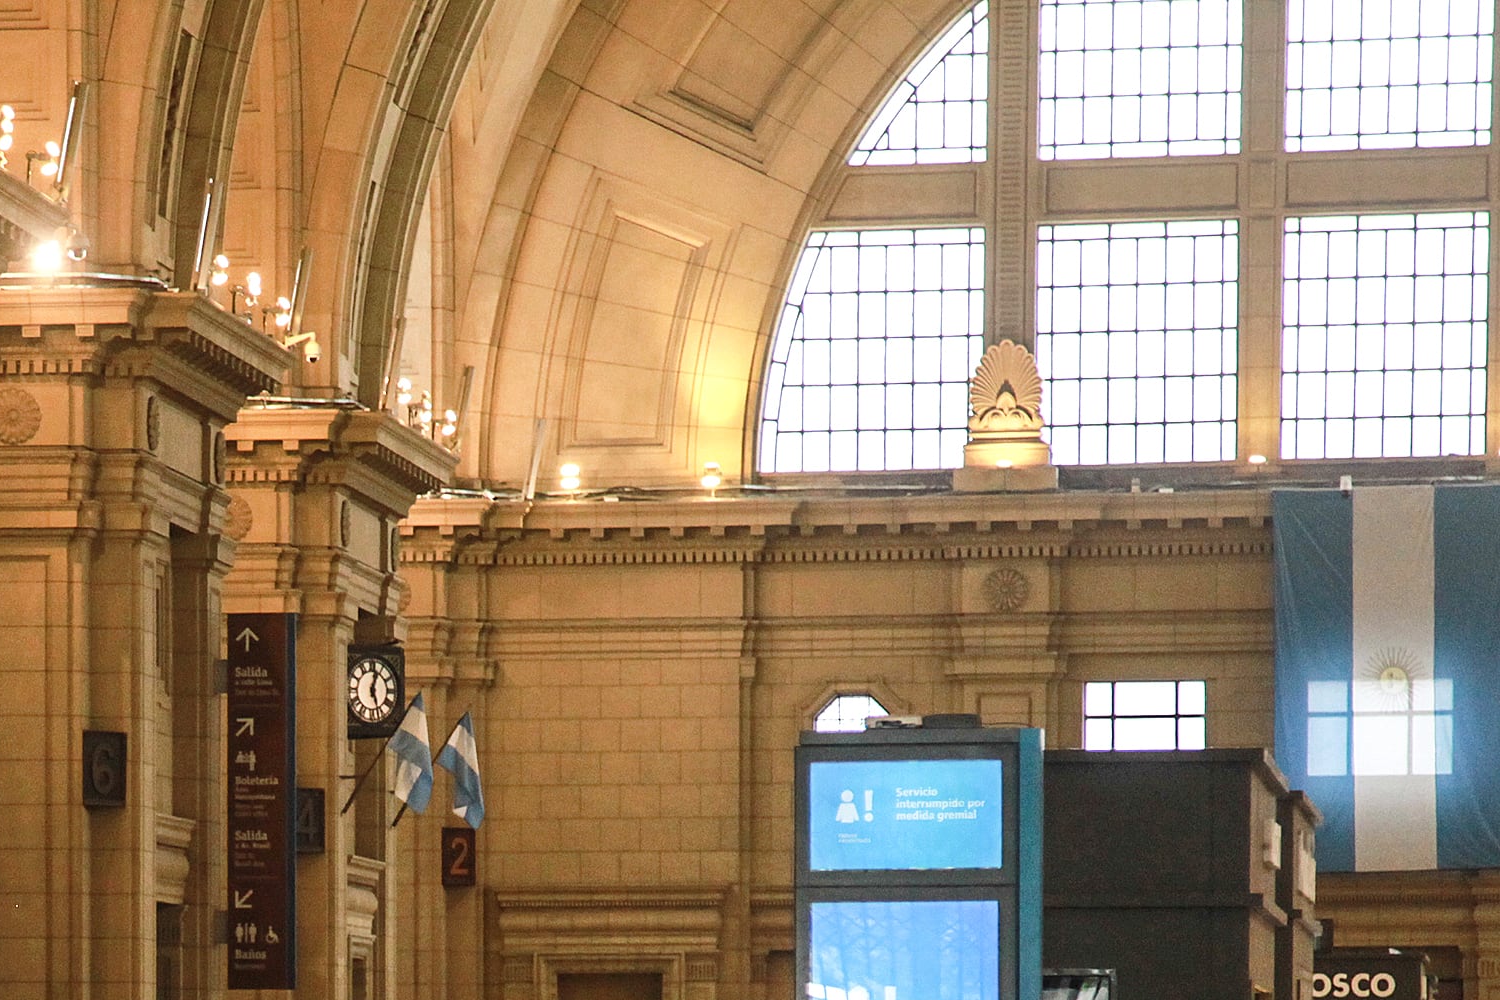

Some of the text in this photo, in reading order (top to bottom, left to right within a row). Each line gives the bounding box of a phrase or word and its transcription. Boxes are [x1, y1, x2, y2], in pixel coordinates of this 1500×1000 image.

[235, 667, 268, 677] Salida
[895, 787, 938, 798] Servicio
[896, 798, 986, 811] interrumpido por
[896, 810, 977, 823] medida gremial
[235, 830, 268, 841] Salida
[450, 837, 469, 876] 2
